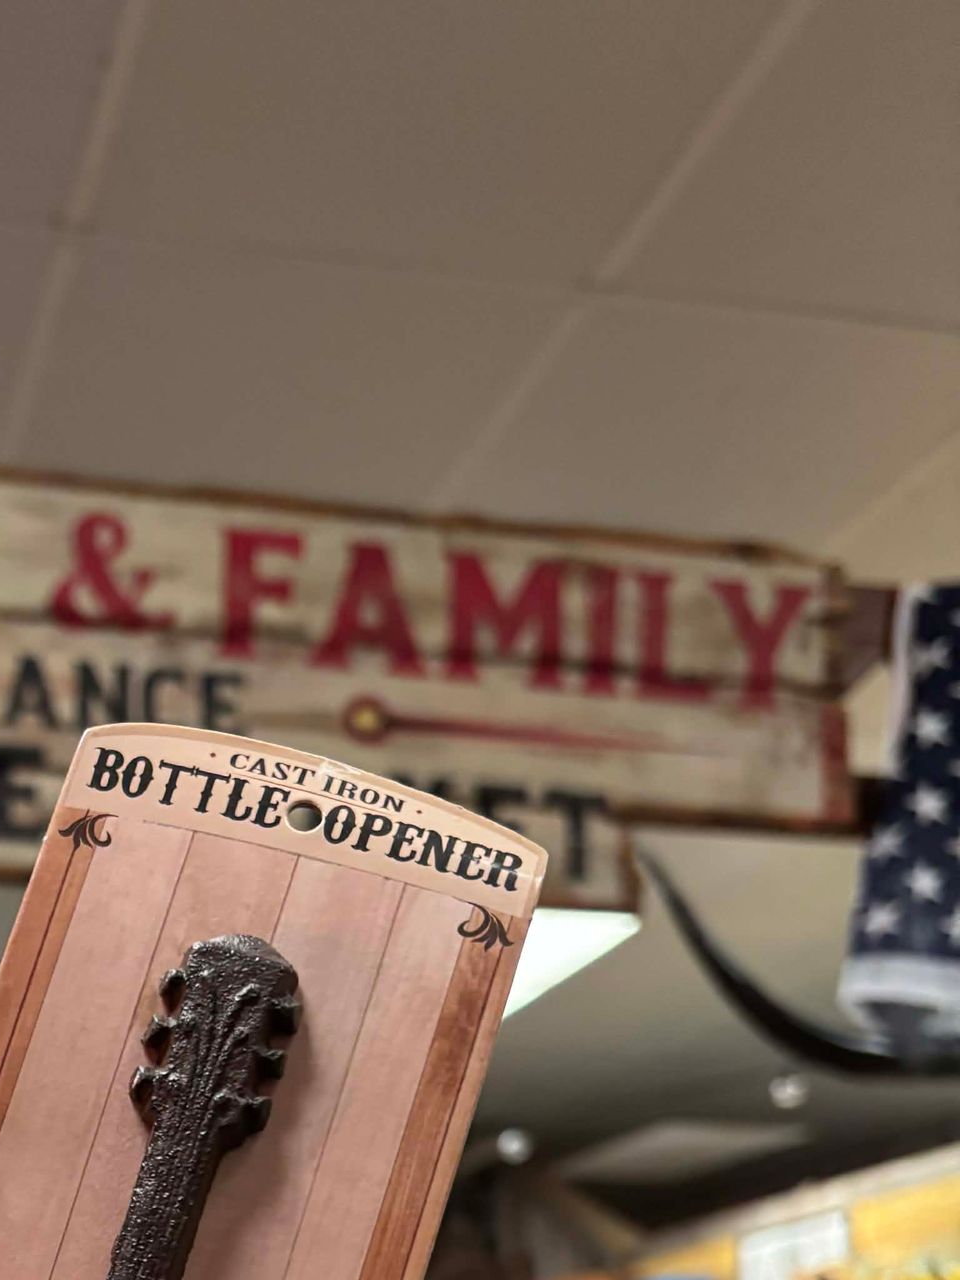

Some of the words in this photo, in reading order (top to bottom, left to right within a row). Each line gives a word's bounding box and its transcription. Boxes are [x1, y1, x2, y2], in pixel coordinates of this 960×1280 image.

[50, 510, 175, 632] &
[216, 526, 811, 712] FAMILY
[86, 746, 291, 829] BOTTLE
[321, 804, 523, 892] OPENER
[229, 752, 318, 789] CAST
[320, 775, 405, 813] IRON
